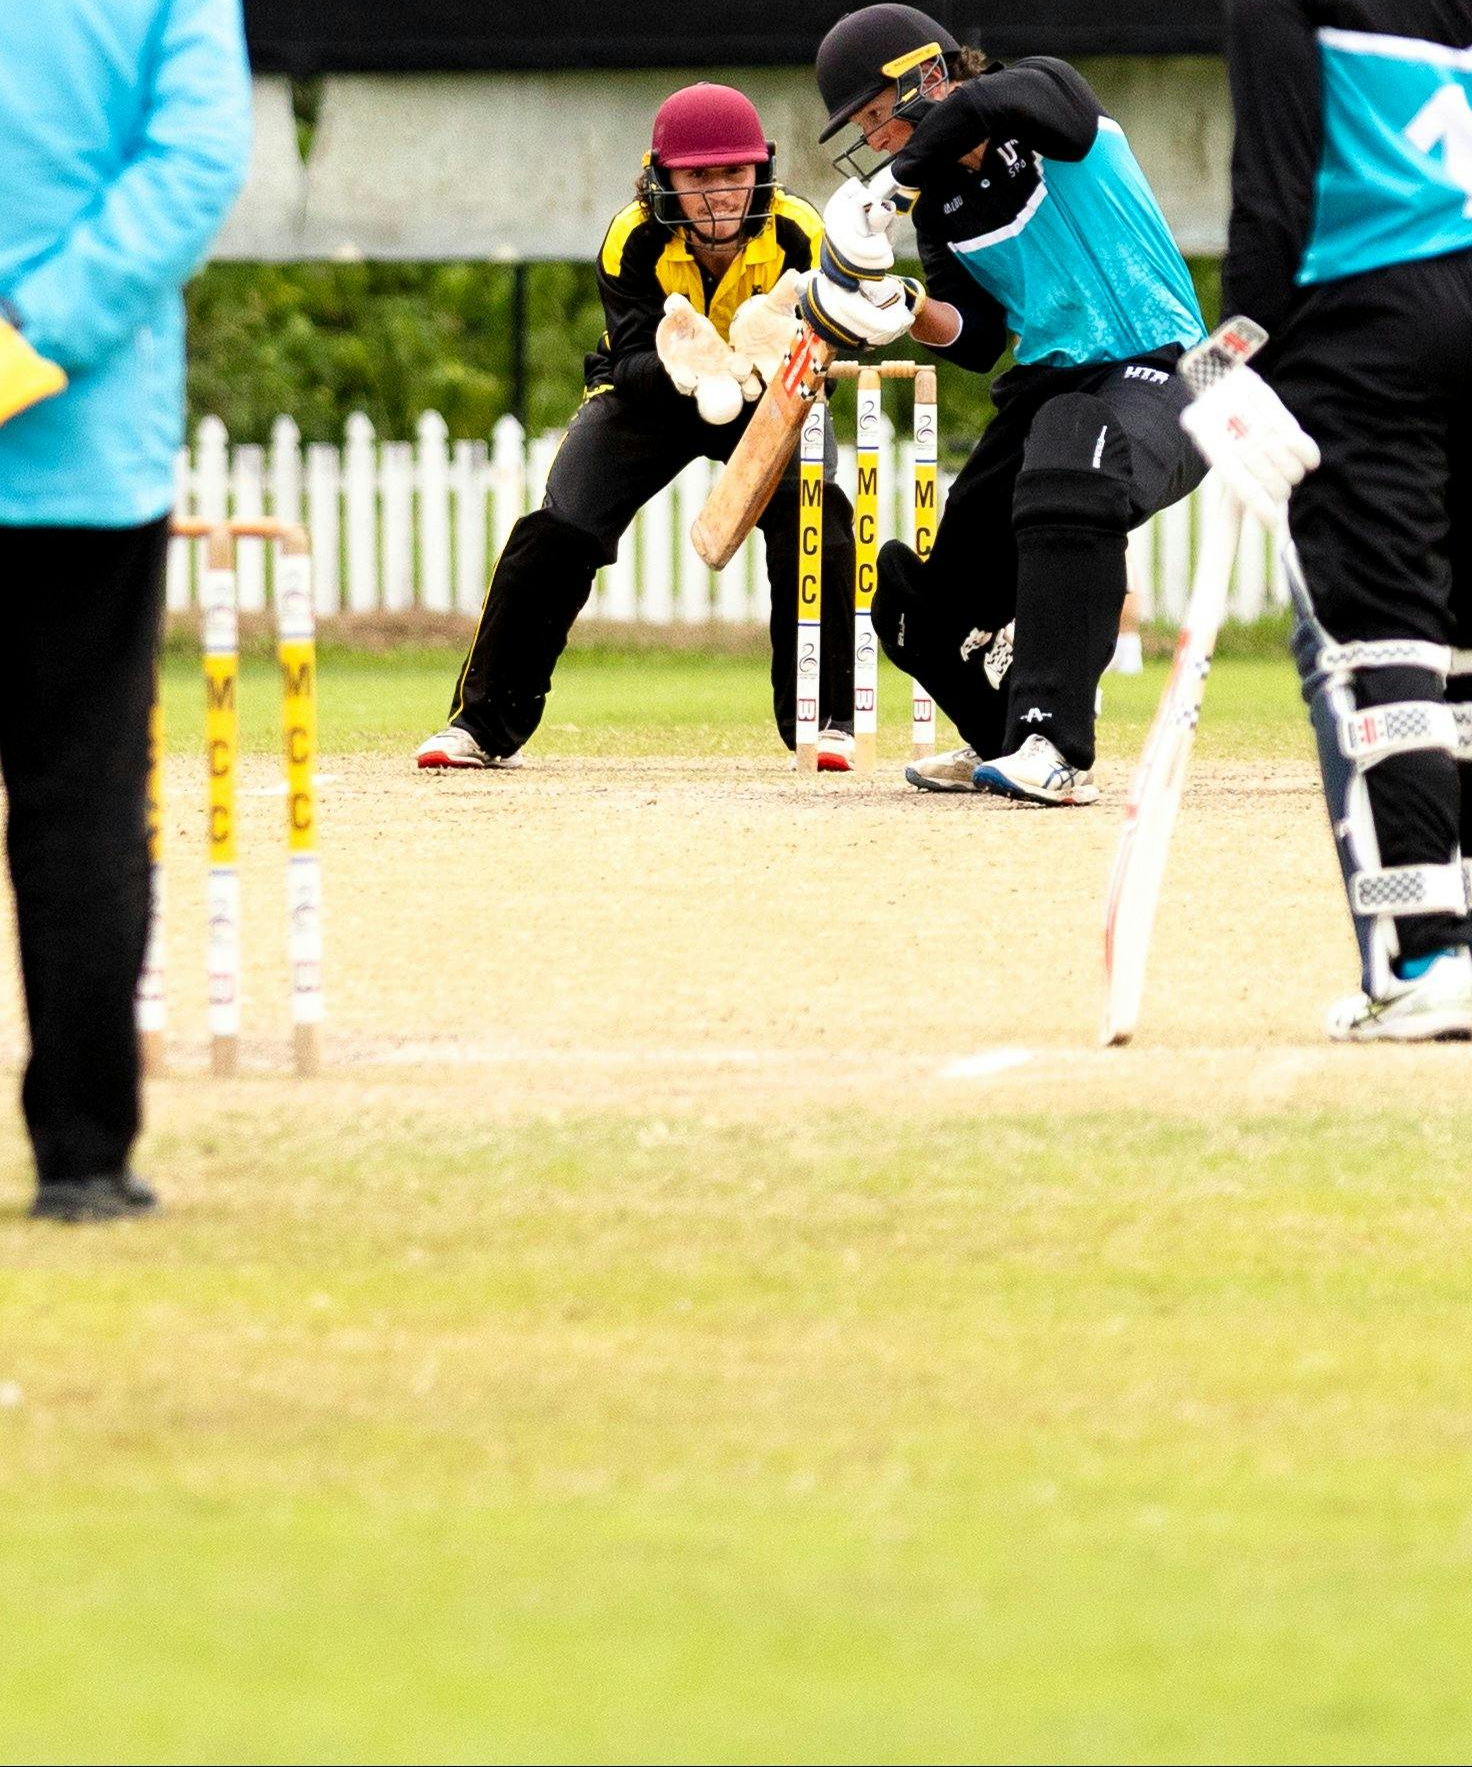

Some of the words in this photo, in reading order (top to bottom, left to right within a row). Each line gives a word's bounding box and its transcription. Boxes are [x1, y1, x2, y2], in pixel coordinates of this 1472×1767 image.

[801, 479, 822, 605] MCC
[857, 467, 878, 594] MCC
[914, 480, 935, 557] MC
[207, 674, 234, 844] MCC
[284, 662, 311, 832] MCC
